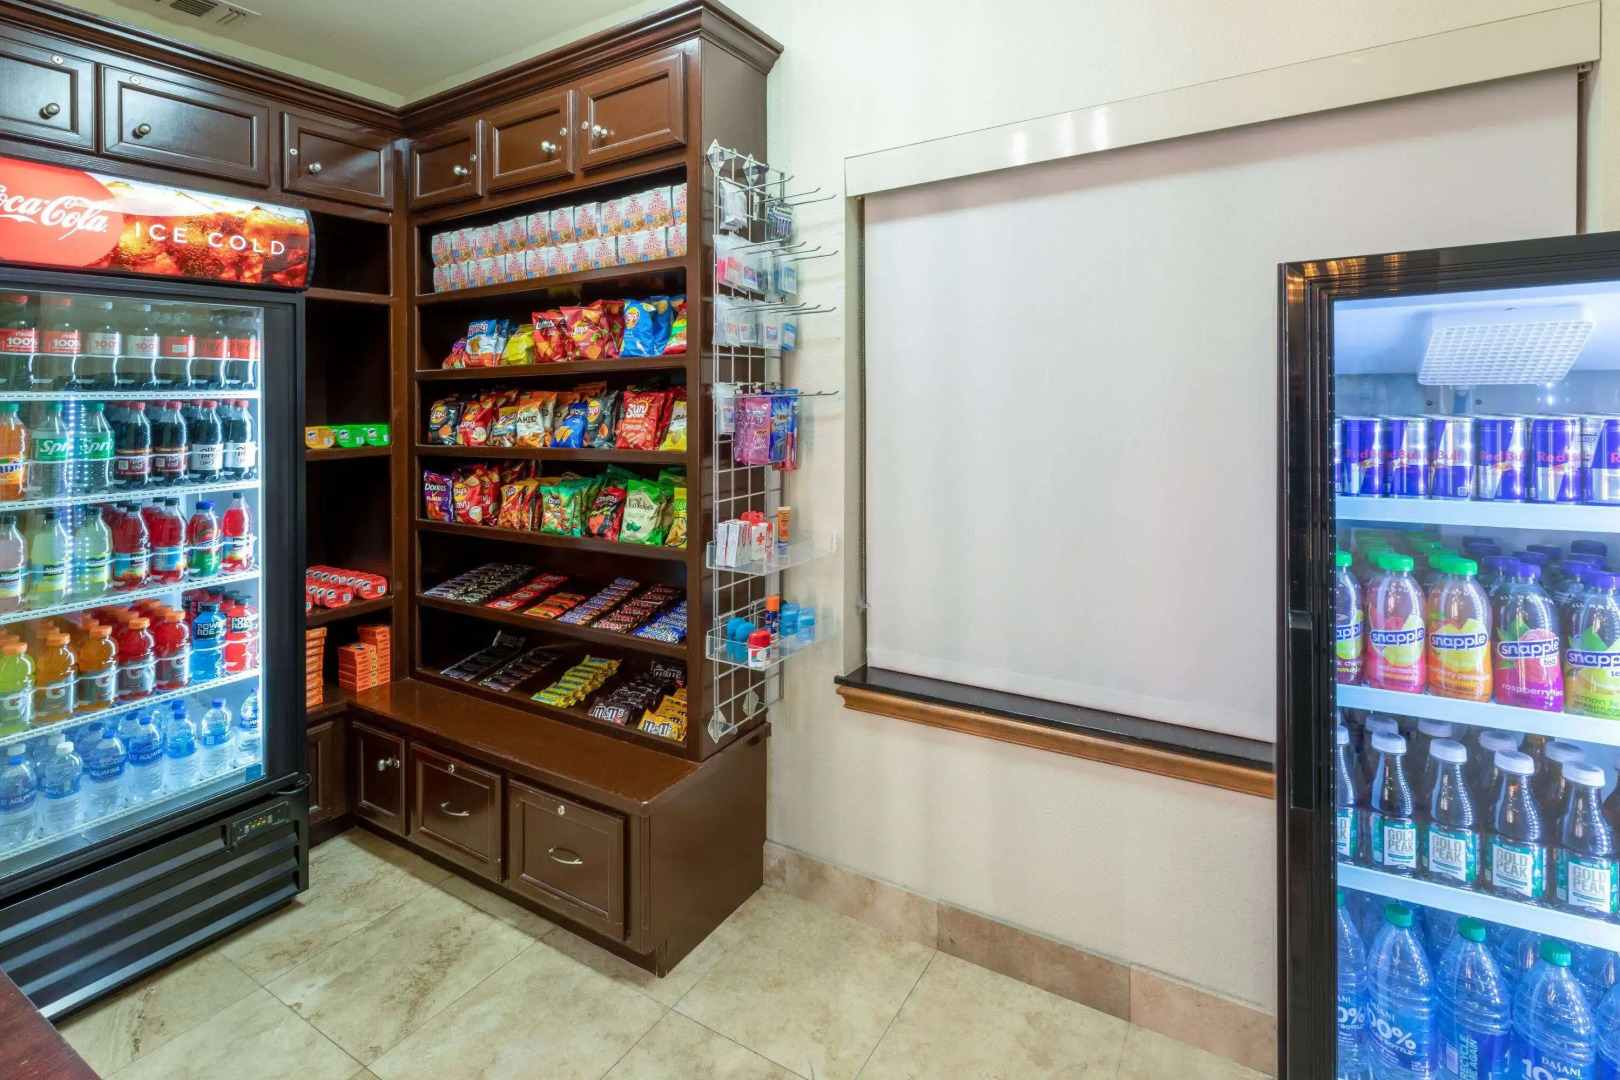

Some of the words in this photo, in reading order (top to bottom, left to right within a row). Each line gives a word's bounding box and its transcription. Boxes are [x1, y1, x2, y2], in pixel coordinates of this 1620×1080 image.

[134, 221, 188, 244] ICE
[208, 232, 286, 256] COLD
[517, 415, 538, 424] AKED
[1372, 627, 1425, 646] snapple
[1432, 632, 1486, 650] snapple
[1501, 639, 1559, 658] snapple
[1544, 657, 1556, 666] tea
[1388, 829, 1414, 842] GOLD
[1432, 834, 1462, 852] GOLD
[1388, 839, 1414, 852] PEAK
[1432, 844, 1462, 863] PEAK
[1497, 848, 1528, 867] GOLD
[1497, 858, 1528, 878] PEAK
[1573, 865, 1607, 883] GOLD
[1573, 876, 1607, 895] PEAK
[1367, 1004, 1417, 1050] 00%
[1522, 1058, 1570, 1080] 10
[1541, 1056, 1582, 1077] DASANI
